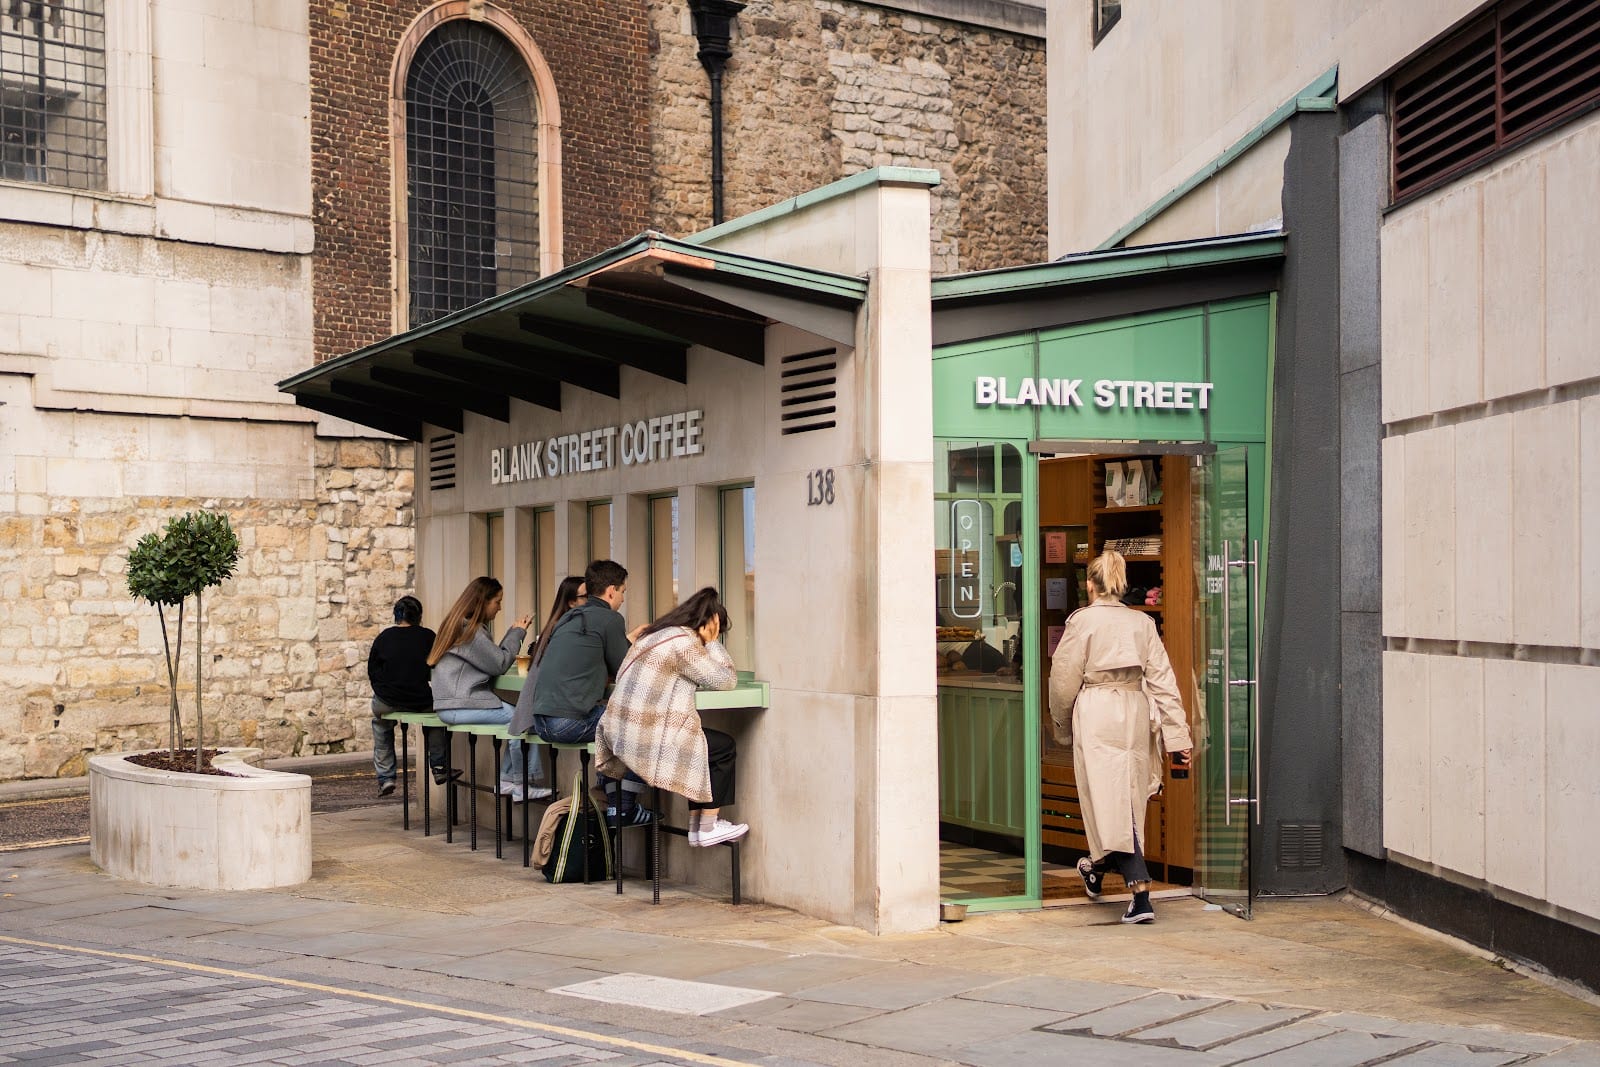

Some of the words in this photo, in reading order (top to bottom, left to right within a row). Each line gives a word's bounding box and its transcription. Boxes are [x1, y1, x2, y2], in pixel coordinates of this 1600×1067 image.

[975, 376, 1084, 406] BLANK
[1093, 379, 1214, 409] STREET
[491, 440, 545, 485] BLANK
[547, 427, 618, 477] STREET
[620, 409, 704, 465] COFFEE
[806, 468, 836, 506] 138
[960, 515, 974, 602] OPEN
